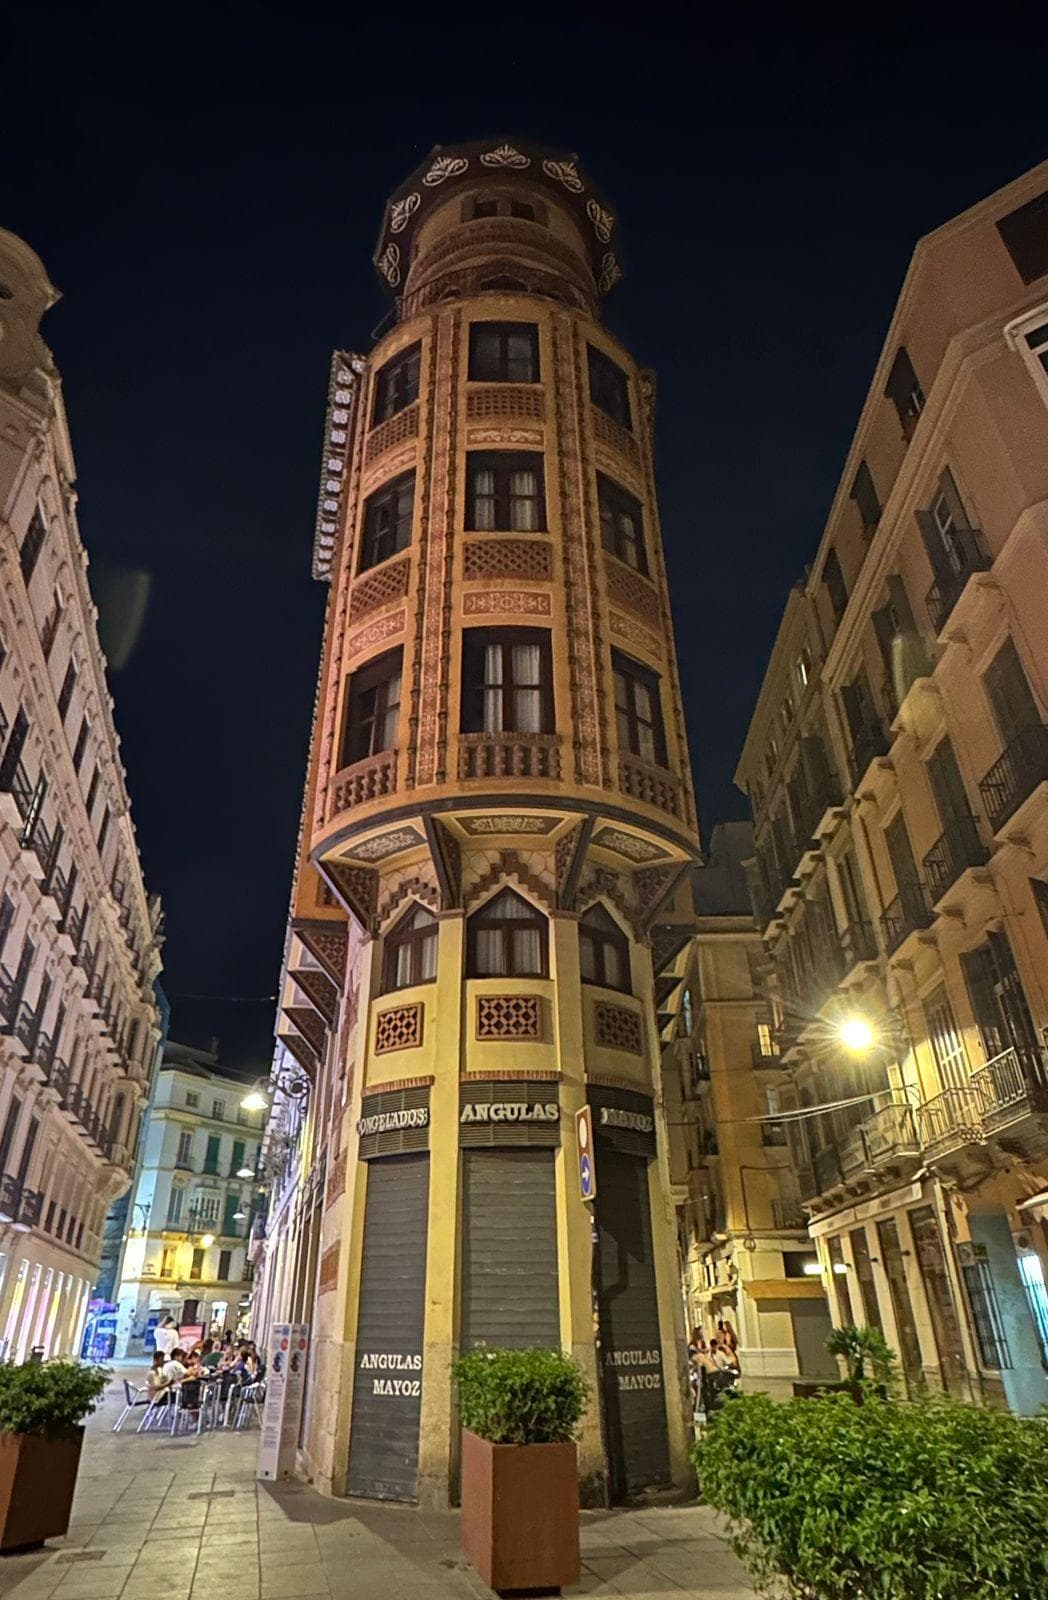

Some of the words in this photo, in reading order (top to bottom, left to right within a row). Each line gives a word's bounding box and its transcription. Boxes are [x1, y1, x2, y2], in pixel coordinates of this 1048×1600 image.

[460, 1103, 559, 1123] ANGULAS
[360, 1354, 422, 1371] ANGULAS
[605, 1350, 660, 1367] ANGULAS
[372, 1379, 421, 1397] MAYOZ
[618, 1374, 661, 1391] MAYOZ
